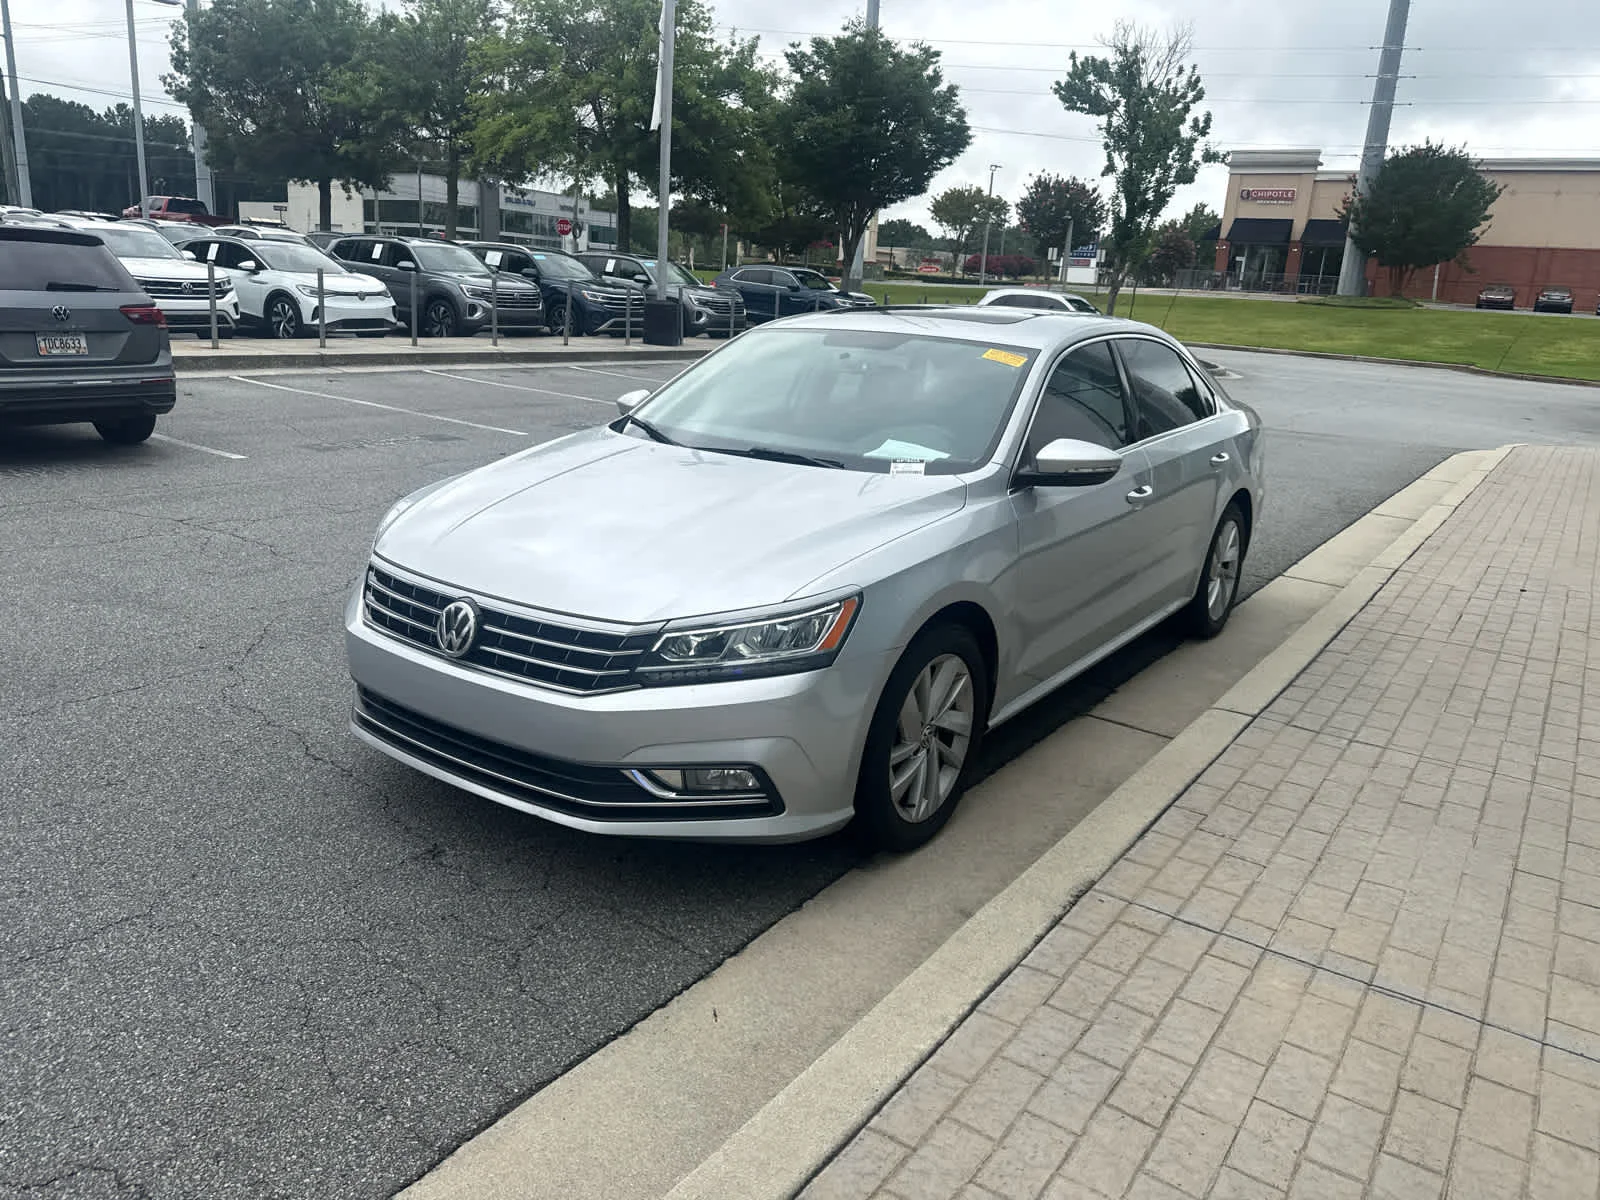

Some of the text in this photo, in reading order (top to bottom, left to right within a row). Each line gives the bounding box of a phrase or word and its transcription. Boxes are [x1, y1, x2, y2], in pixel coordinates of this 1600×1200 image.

[1252, 190, 1294, 198] CHIPOTLE
[557, 223, 571, 231] STOP
[437, 601, 475, 657] VW
